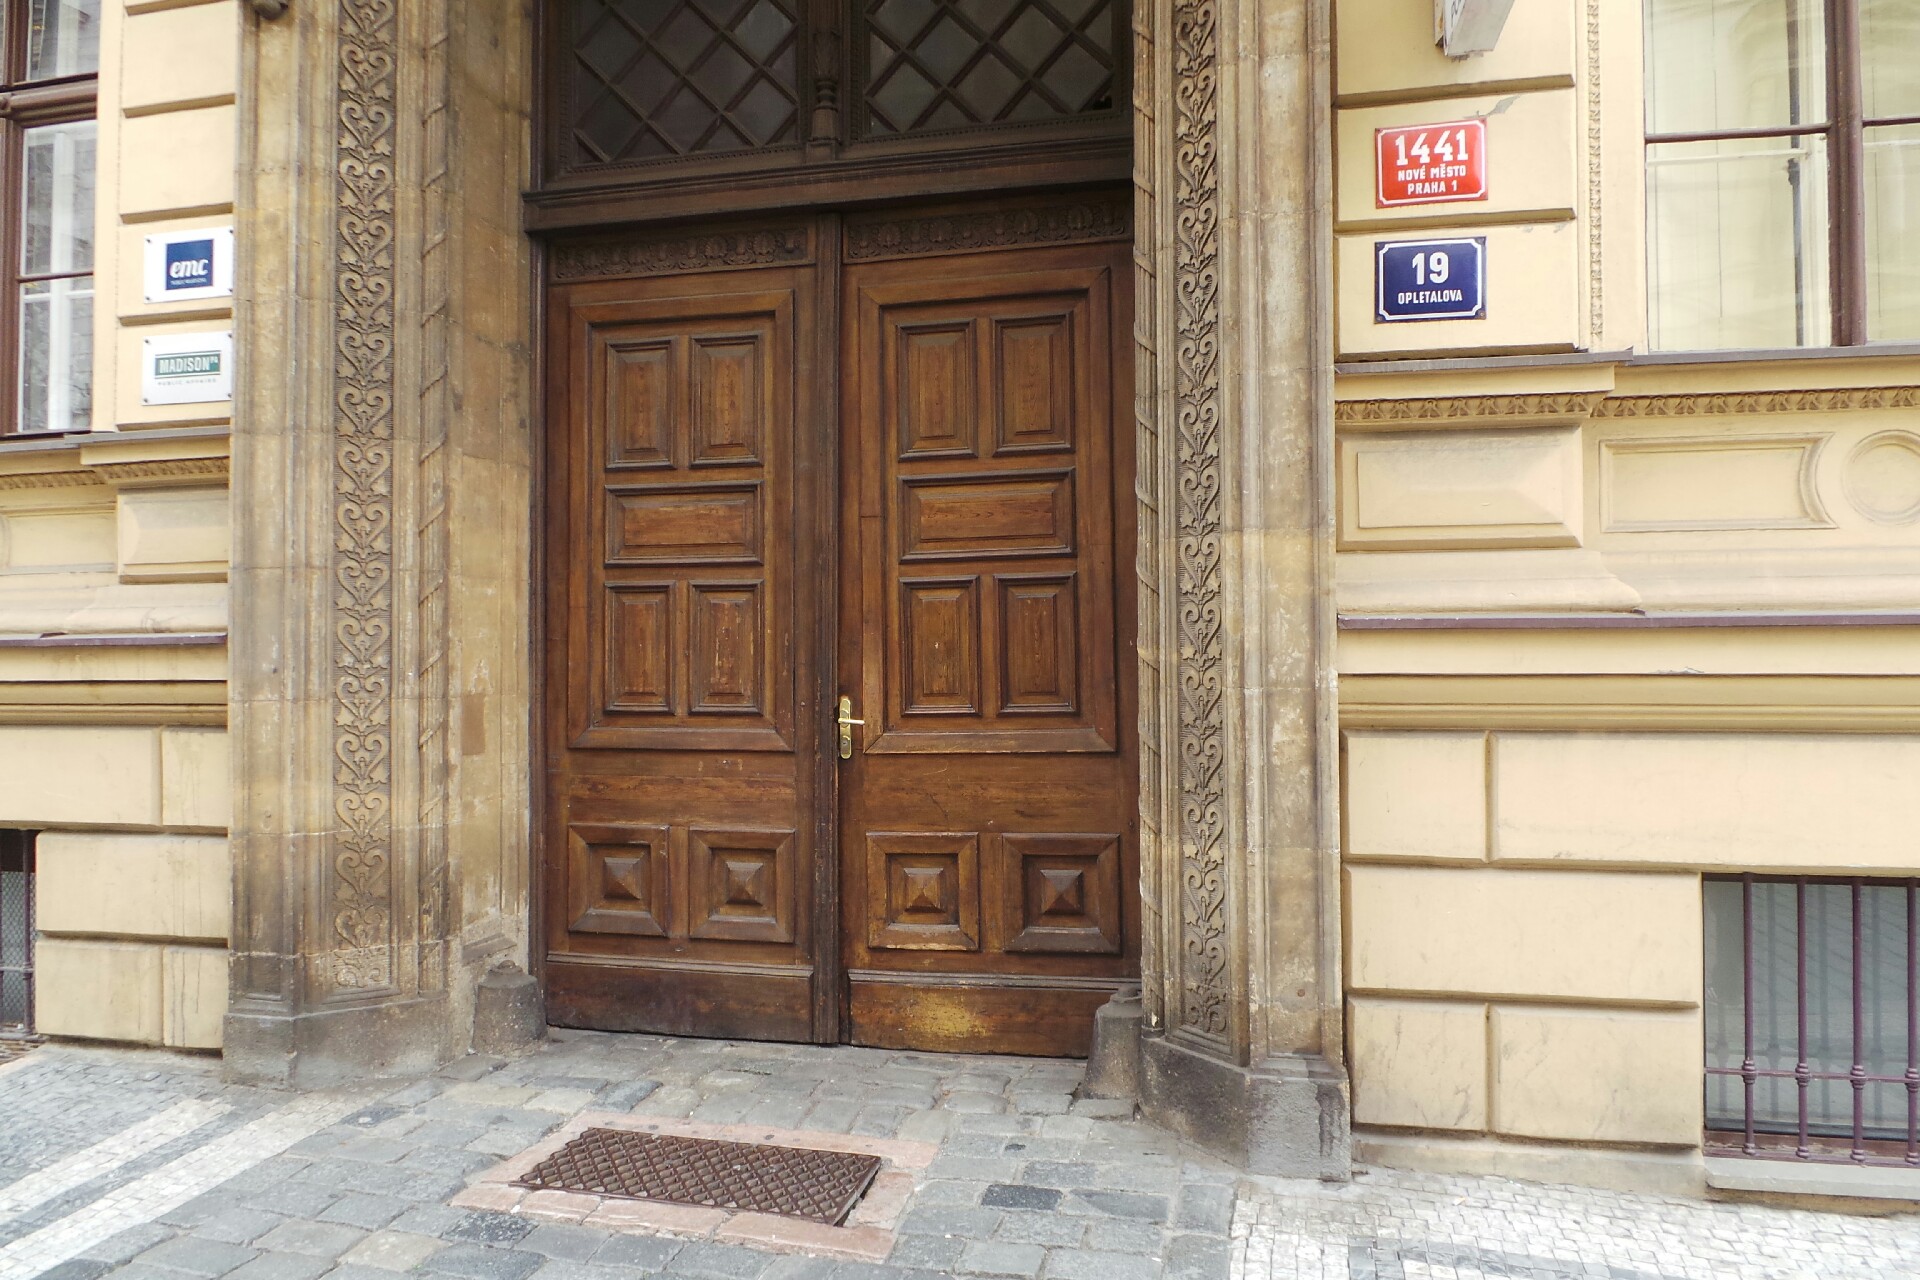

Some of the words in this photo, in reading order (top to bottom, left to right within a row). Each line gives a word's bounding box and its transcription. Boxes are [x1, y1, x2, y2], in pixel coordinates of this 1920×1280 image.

[1395, 129, 1469, 166] 1441
[1398, 165, 1426, 182] NOVÉ
[1430, 163, 1467, 179] MĚSTO
[1407, 181, 1446, 195] PRAHA
[1451, 179, 1458, 191] 1
[170, 259, 209, 278] emc
[1412, 251, 1449, 285] 19
[1397, 289, 1463, 305] OPLETALOVA
[159, 356, 210, 374] MADISON
